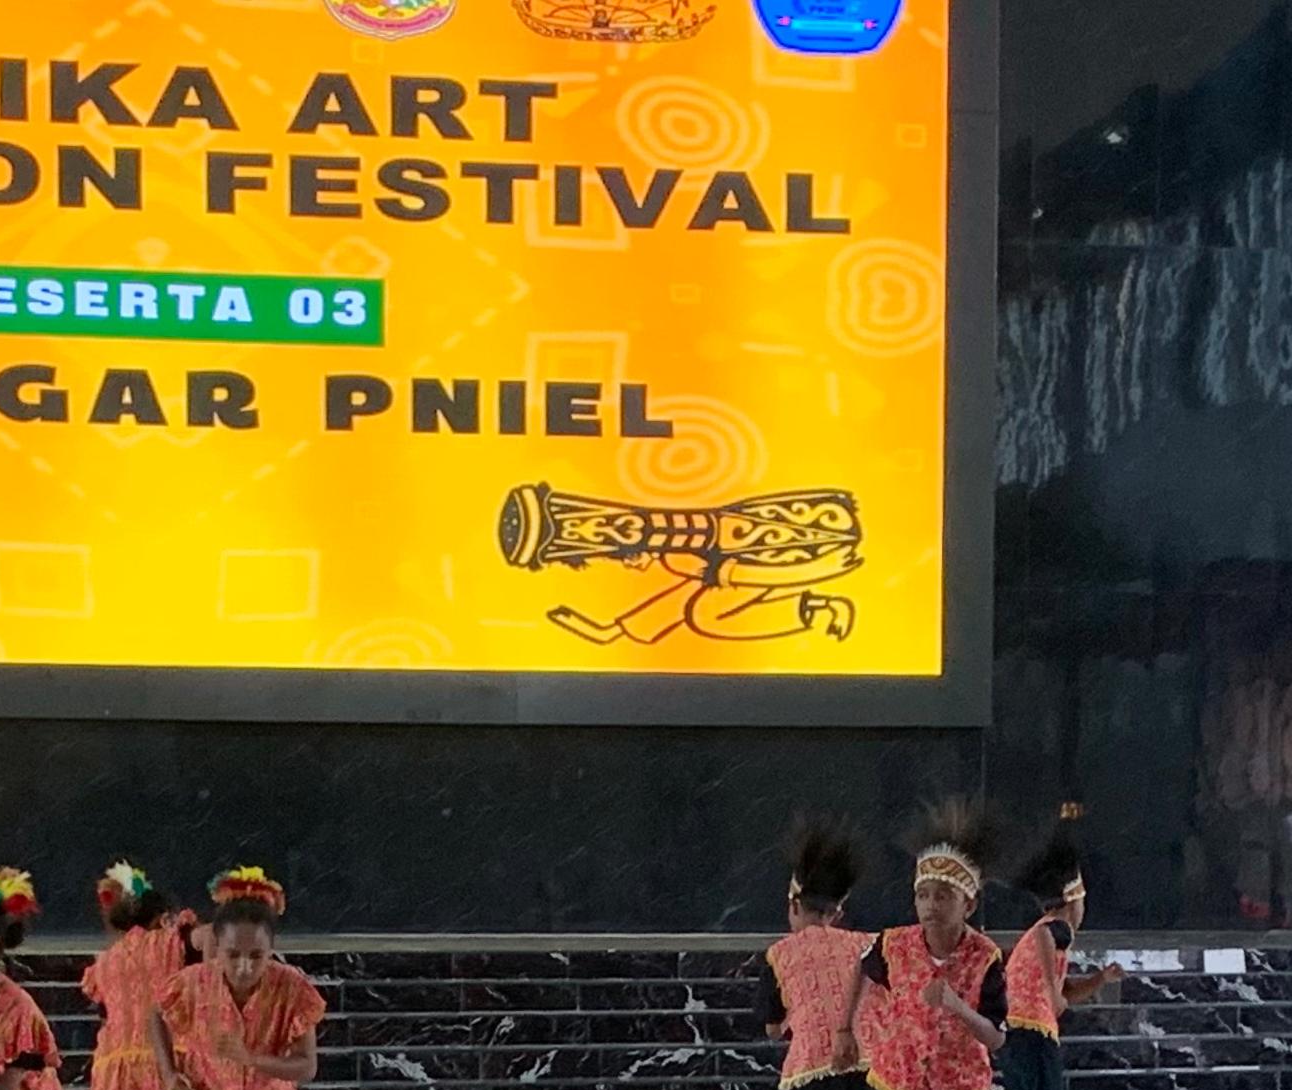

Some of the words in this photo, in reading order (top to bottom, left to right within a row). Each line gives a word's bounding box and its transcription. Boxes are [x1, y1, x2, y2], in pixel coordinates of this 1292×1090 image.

[289, 72, 557, 142] ART
[206, 151, 850, 234] FESTIVAL
[287, 287, 368, 327] 03
[324, 374, 674, 439] PNIEL
